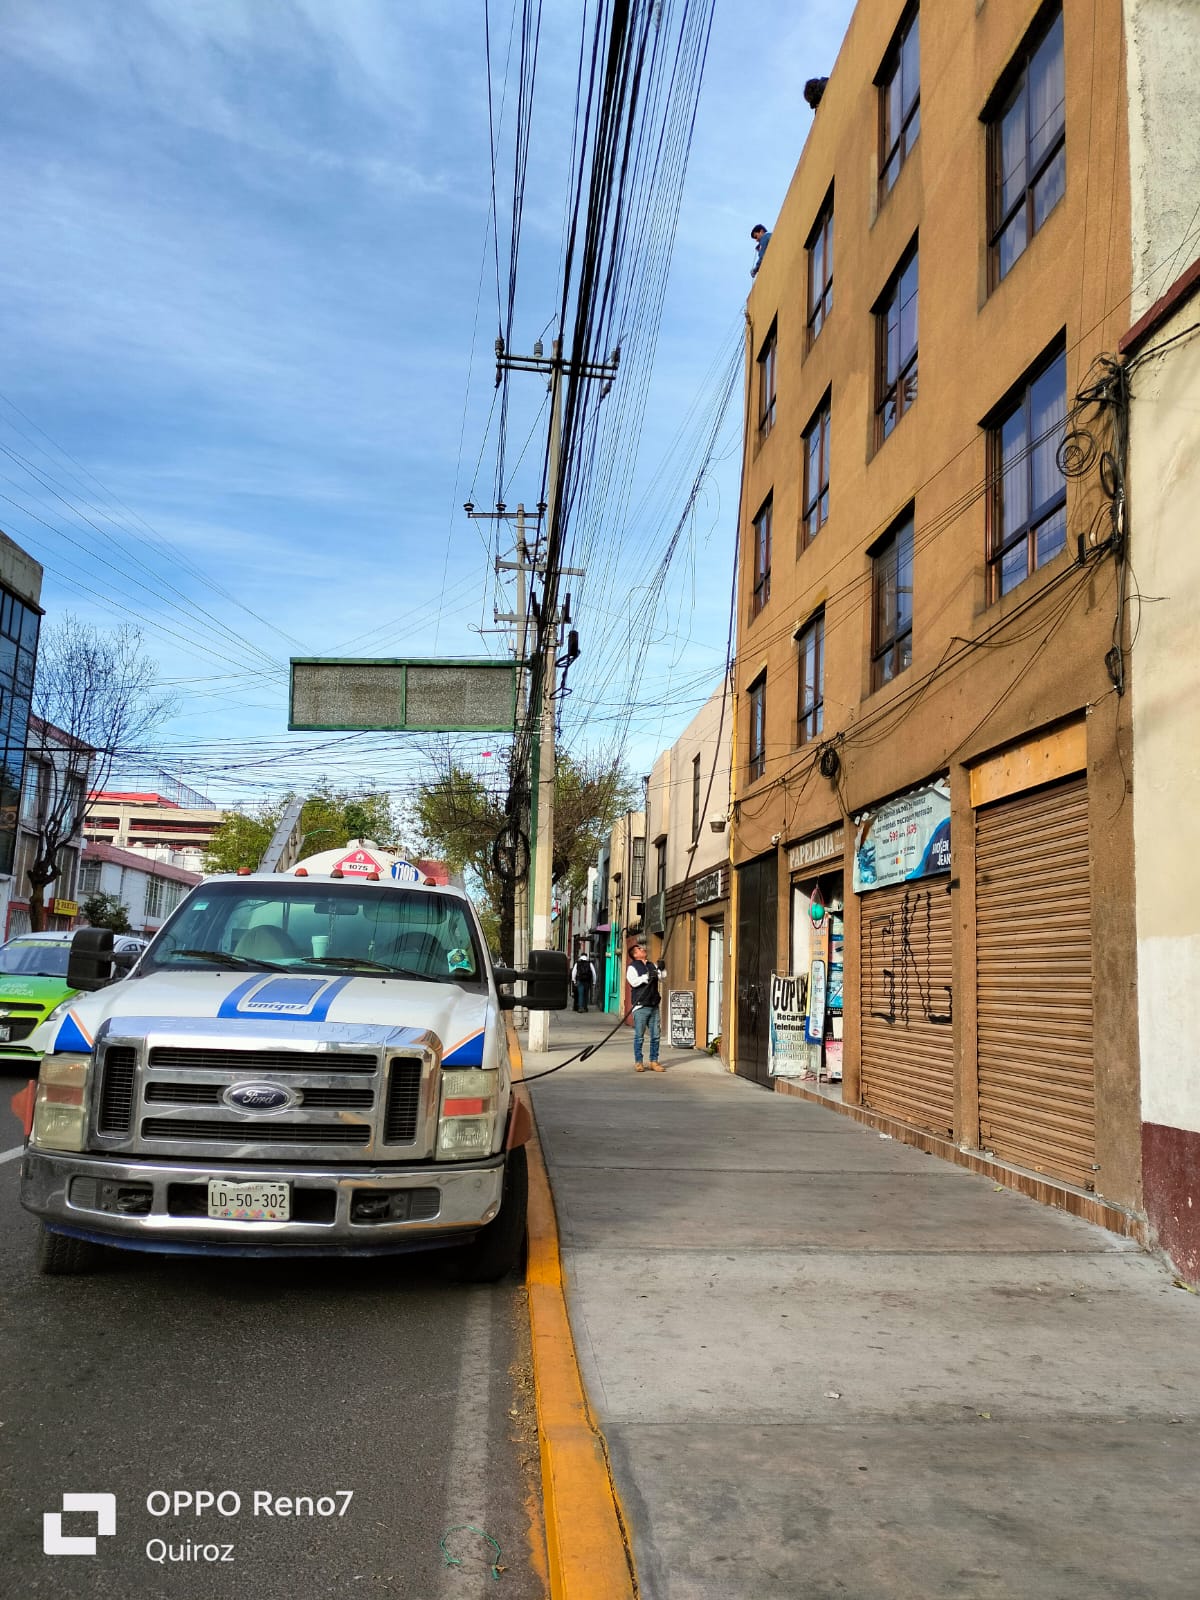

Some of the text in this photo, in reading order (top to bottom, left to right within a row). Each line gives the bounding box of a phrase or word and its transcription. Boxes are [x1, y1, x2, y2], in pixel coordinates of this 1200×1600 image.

[789, 833, 834, 869] PAPELERIA
[242, 1089, 276, 1104] Ford
[211, 1191, 286, 1208] LD-50-302
